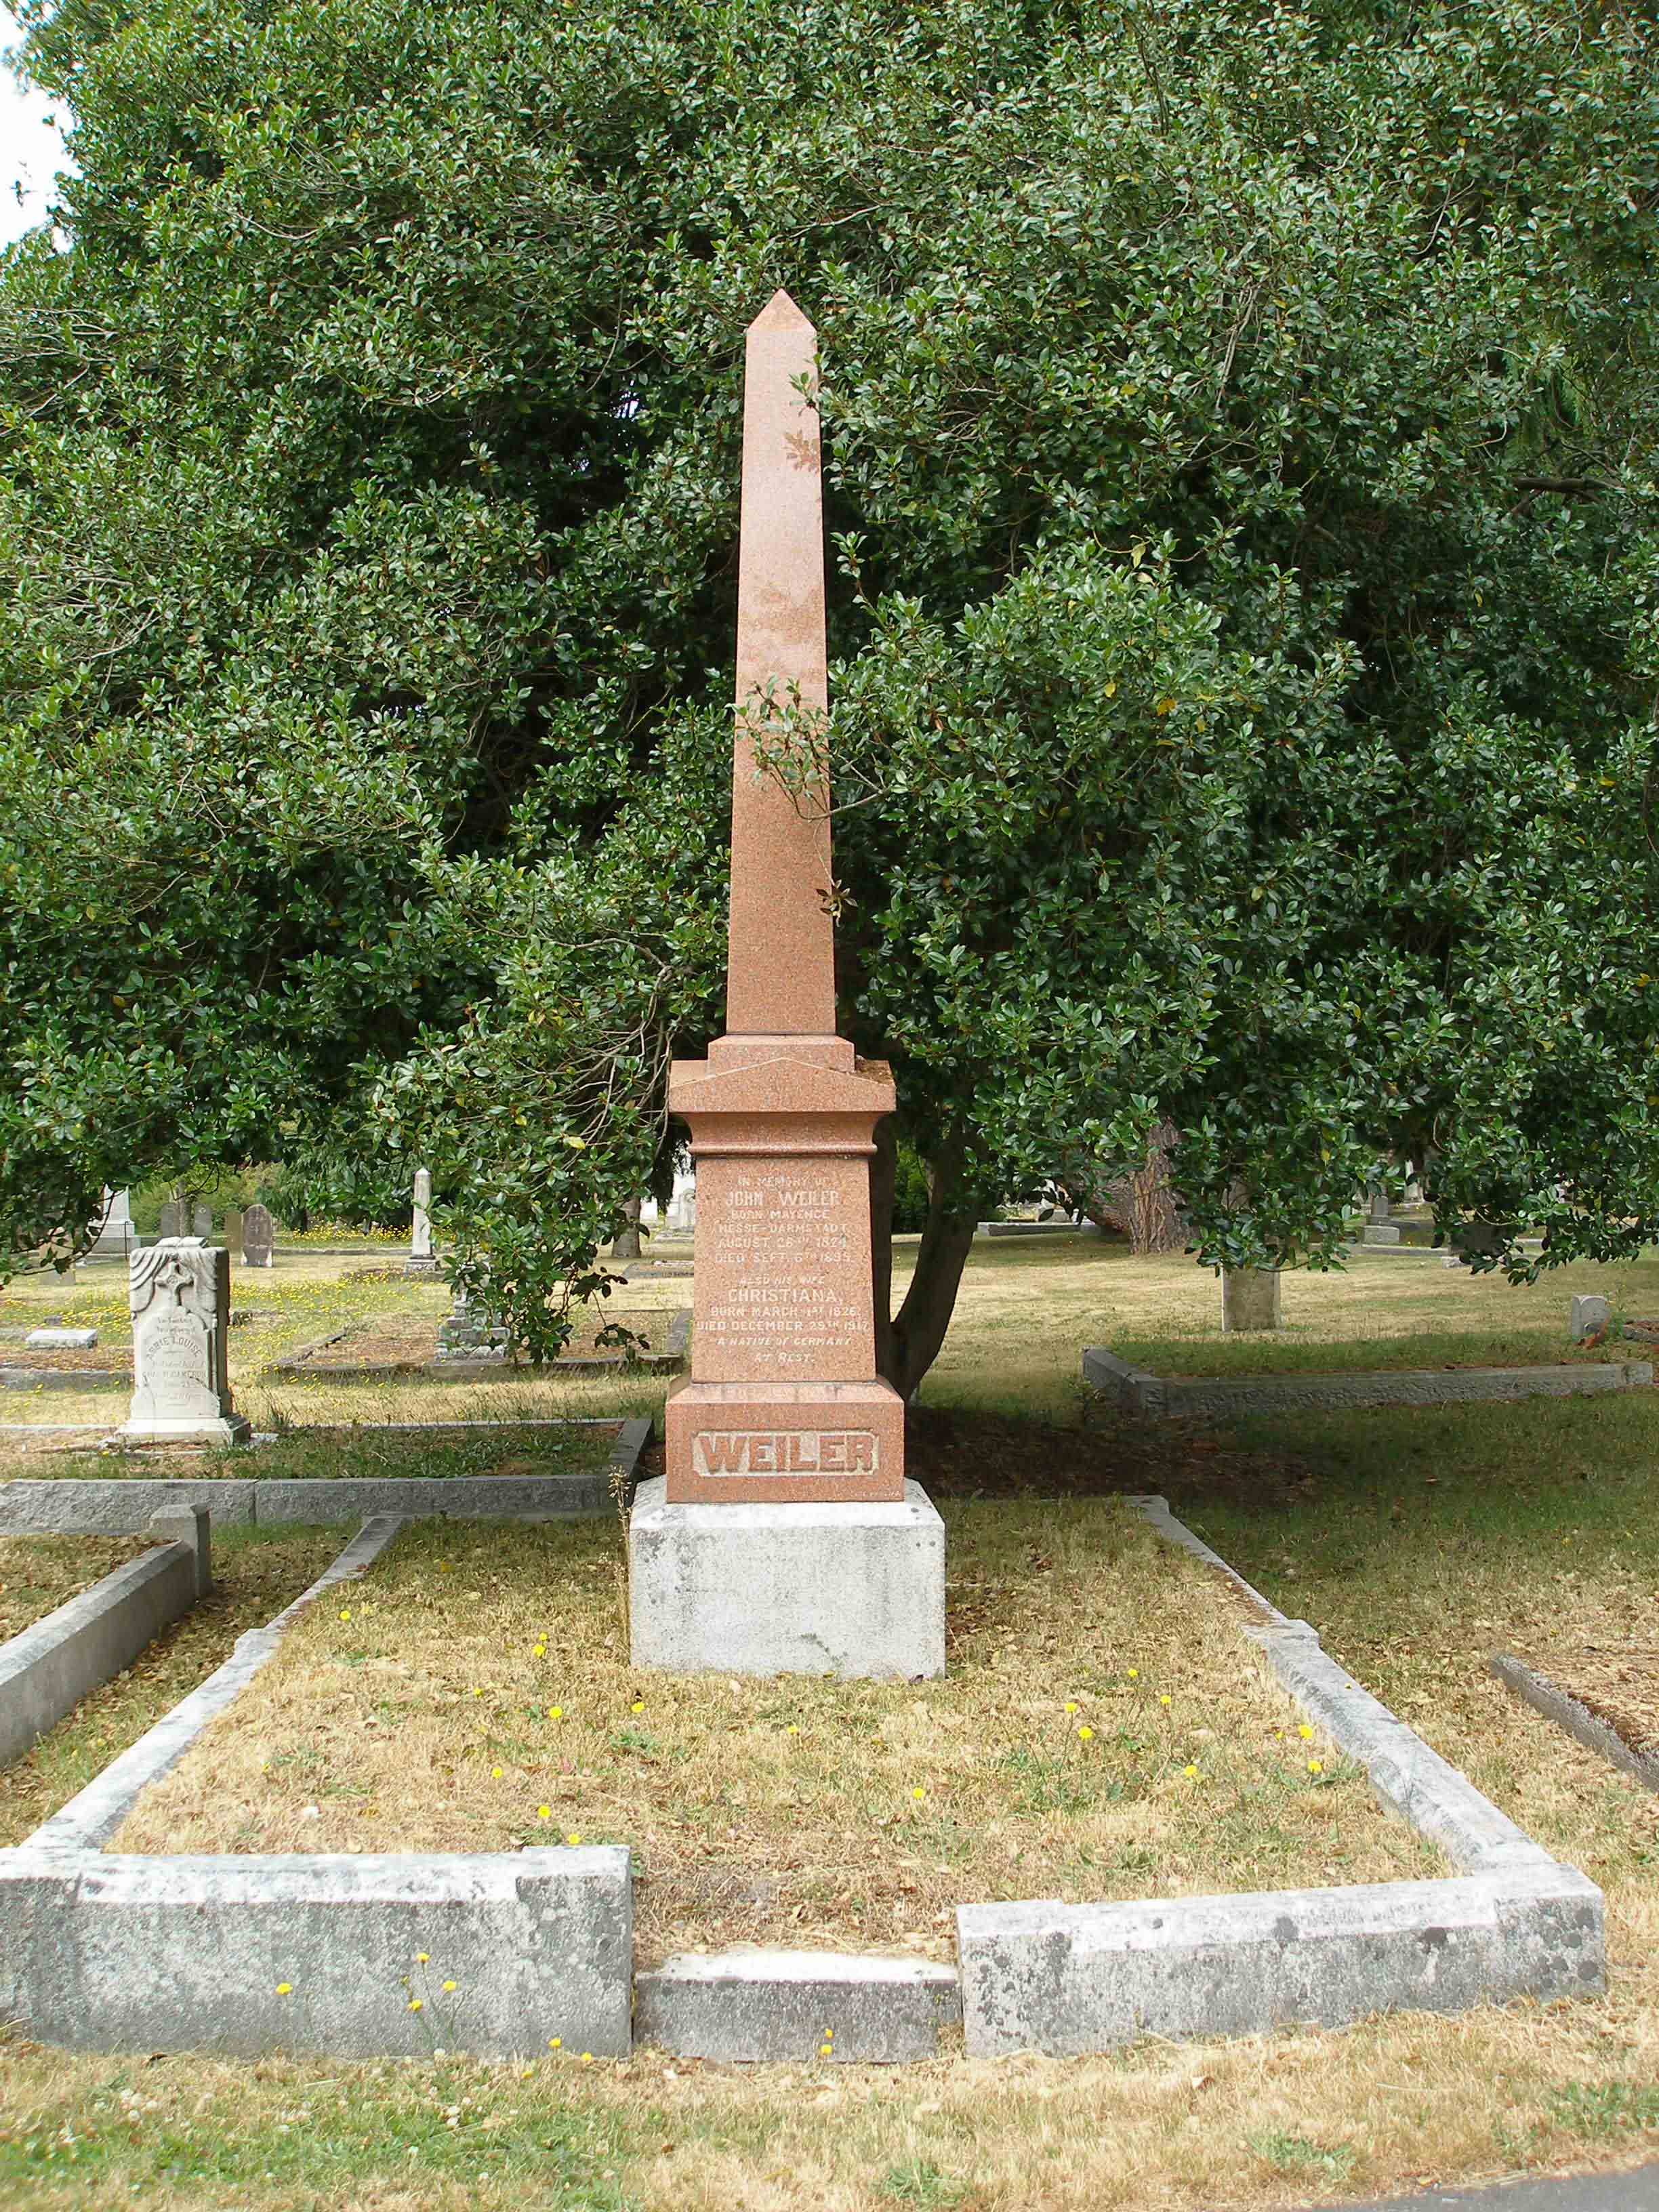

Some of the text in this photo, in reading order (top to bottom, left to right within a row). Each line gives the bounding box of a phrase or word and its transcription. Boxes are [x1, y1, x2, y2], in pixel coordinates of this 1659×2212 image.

[726, 1191, 840, 1206] JOHN WEILER
[770, 1210, 830, 1219] MAYENCE
[775, 1275, 792, 1285] HIS
[710, 1307, 745, 1317] BORN
[752, 1306, 798, 1317] MARCH
[731, 1321, 803, 1330] DECEMBER
[699, 1435, 873, 1474] WEILER
